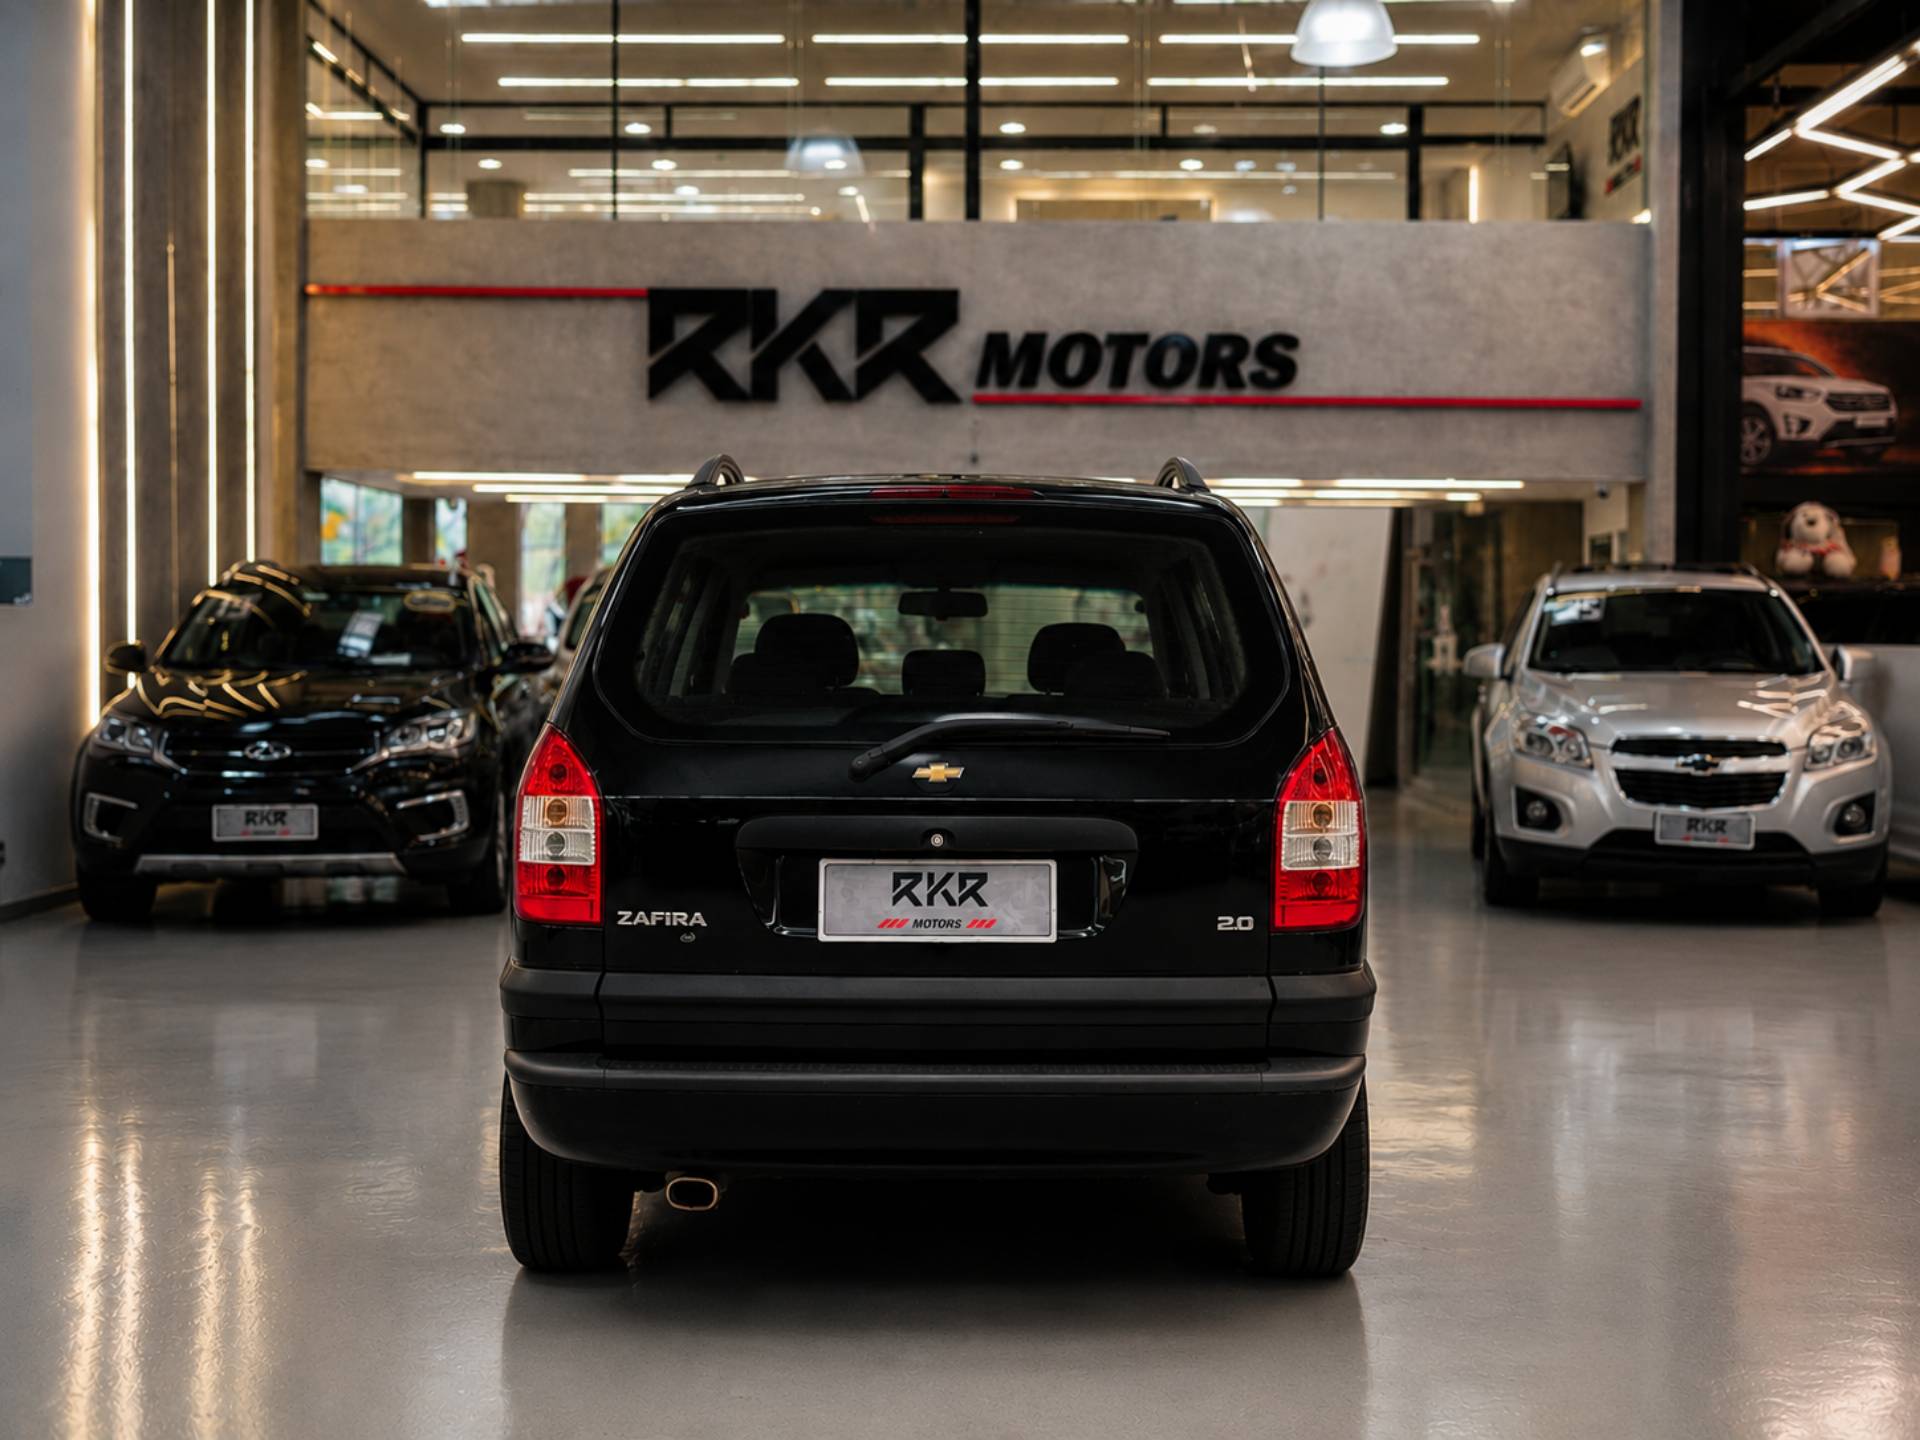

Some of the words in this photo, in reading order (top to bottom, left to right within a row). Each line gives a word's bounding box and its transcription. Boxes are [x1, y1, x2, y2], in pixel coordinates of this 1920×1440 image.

[647, 288, 961, 402] RKR
[976, 331, 1300, 390] MOTORS
[244, 810, 288, 827] RKR
[1686, 817, 1728, 833] RKR
[892, 872, 989, 907] RKR
[617, 910, 708, 927] ZAFIRA
[911, 918, 962, 929] MOTORS
[1217, 916, 1254, 931] 2.0
